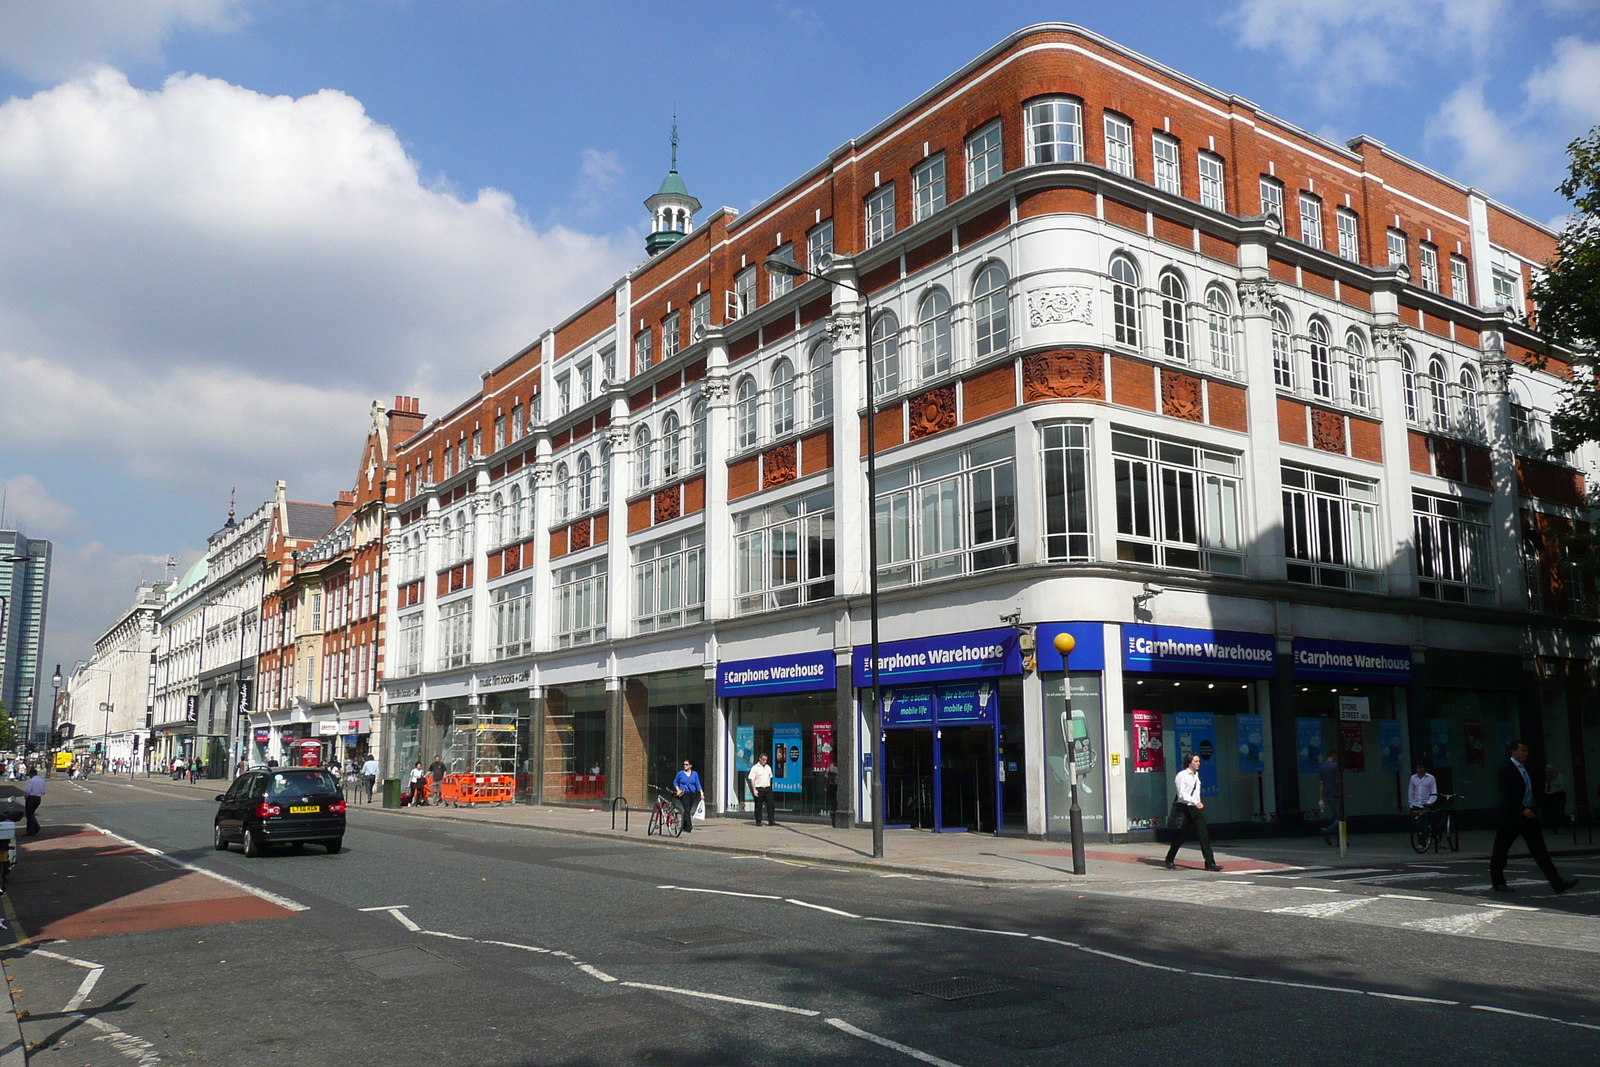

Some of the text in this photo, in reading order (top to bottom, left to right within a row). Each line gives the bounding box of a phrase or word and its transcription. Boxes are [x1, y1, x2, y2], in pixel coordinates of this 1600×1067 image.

[928, 644, 1004, 664] Warehouse
[1136, 638, 1202, 657] Carphone
[1204, 643, 1273, 661] Warehouse
[1300, 650, 1353, 667] Carphone
[1354, 654, 1410, 670] Warehouse
[729, 669, 769, 684] Carphone
[770, 664, 824, 679] Warehouse
[916, 693, 930, 701] better
[958, 690, 975, 698] better
[900, 706, 927, 715] mobile life
[944, 703, 973, 713] mobile life
